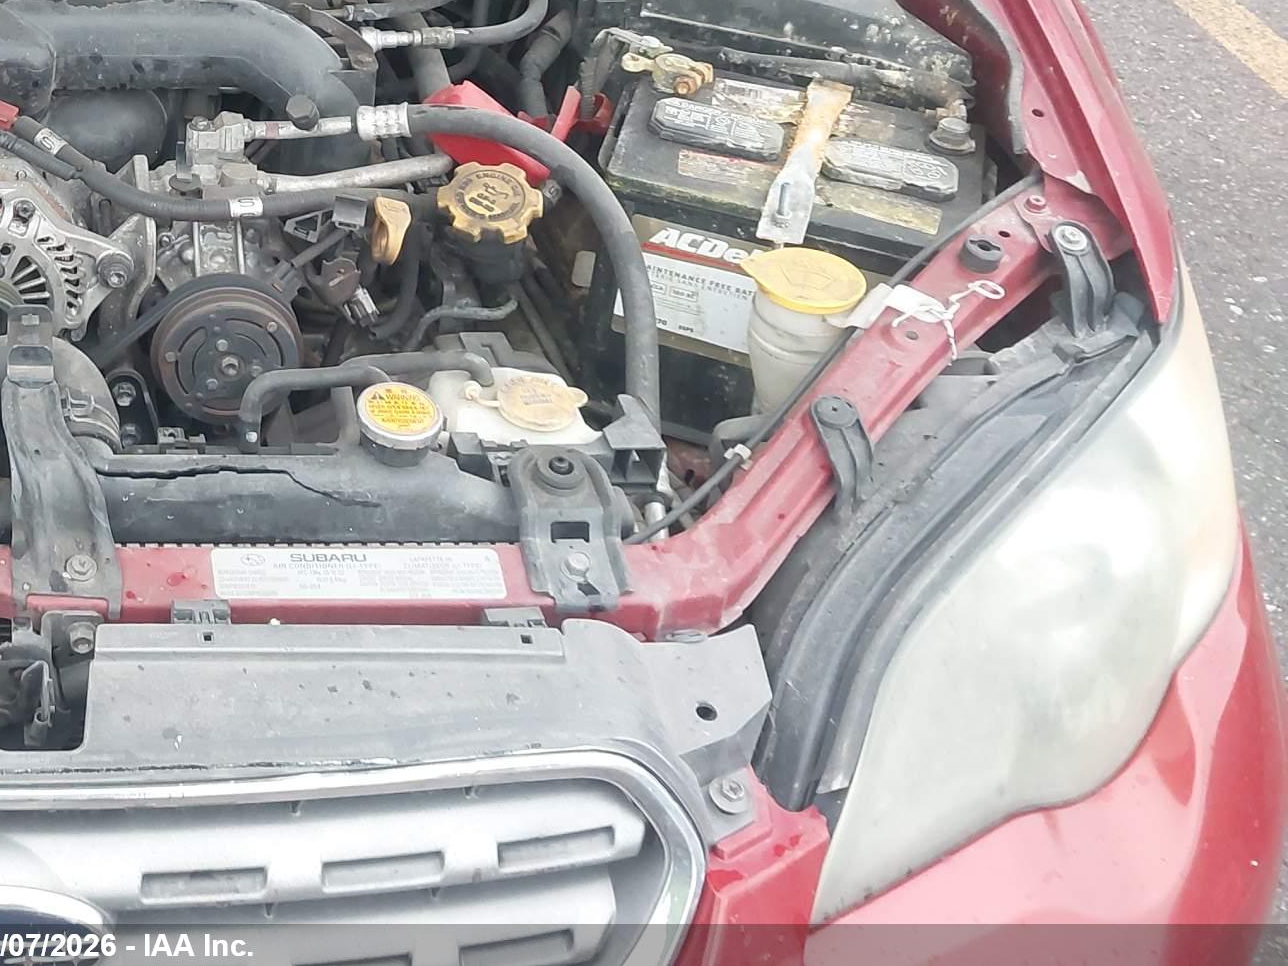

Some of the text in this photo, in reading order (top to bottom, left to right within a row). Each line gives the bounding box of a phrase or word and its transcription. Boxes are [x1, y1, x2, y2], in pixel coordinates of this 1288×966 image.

[647, 264, 706, 284] AINTENANCE
[735, 287, 753, 296] BAT
[289, 553, 367, 563] SUBARU
